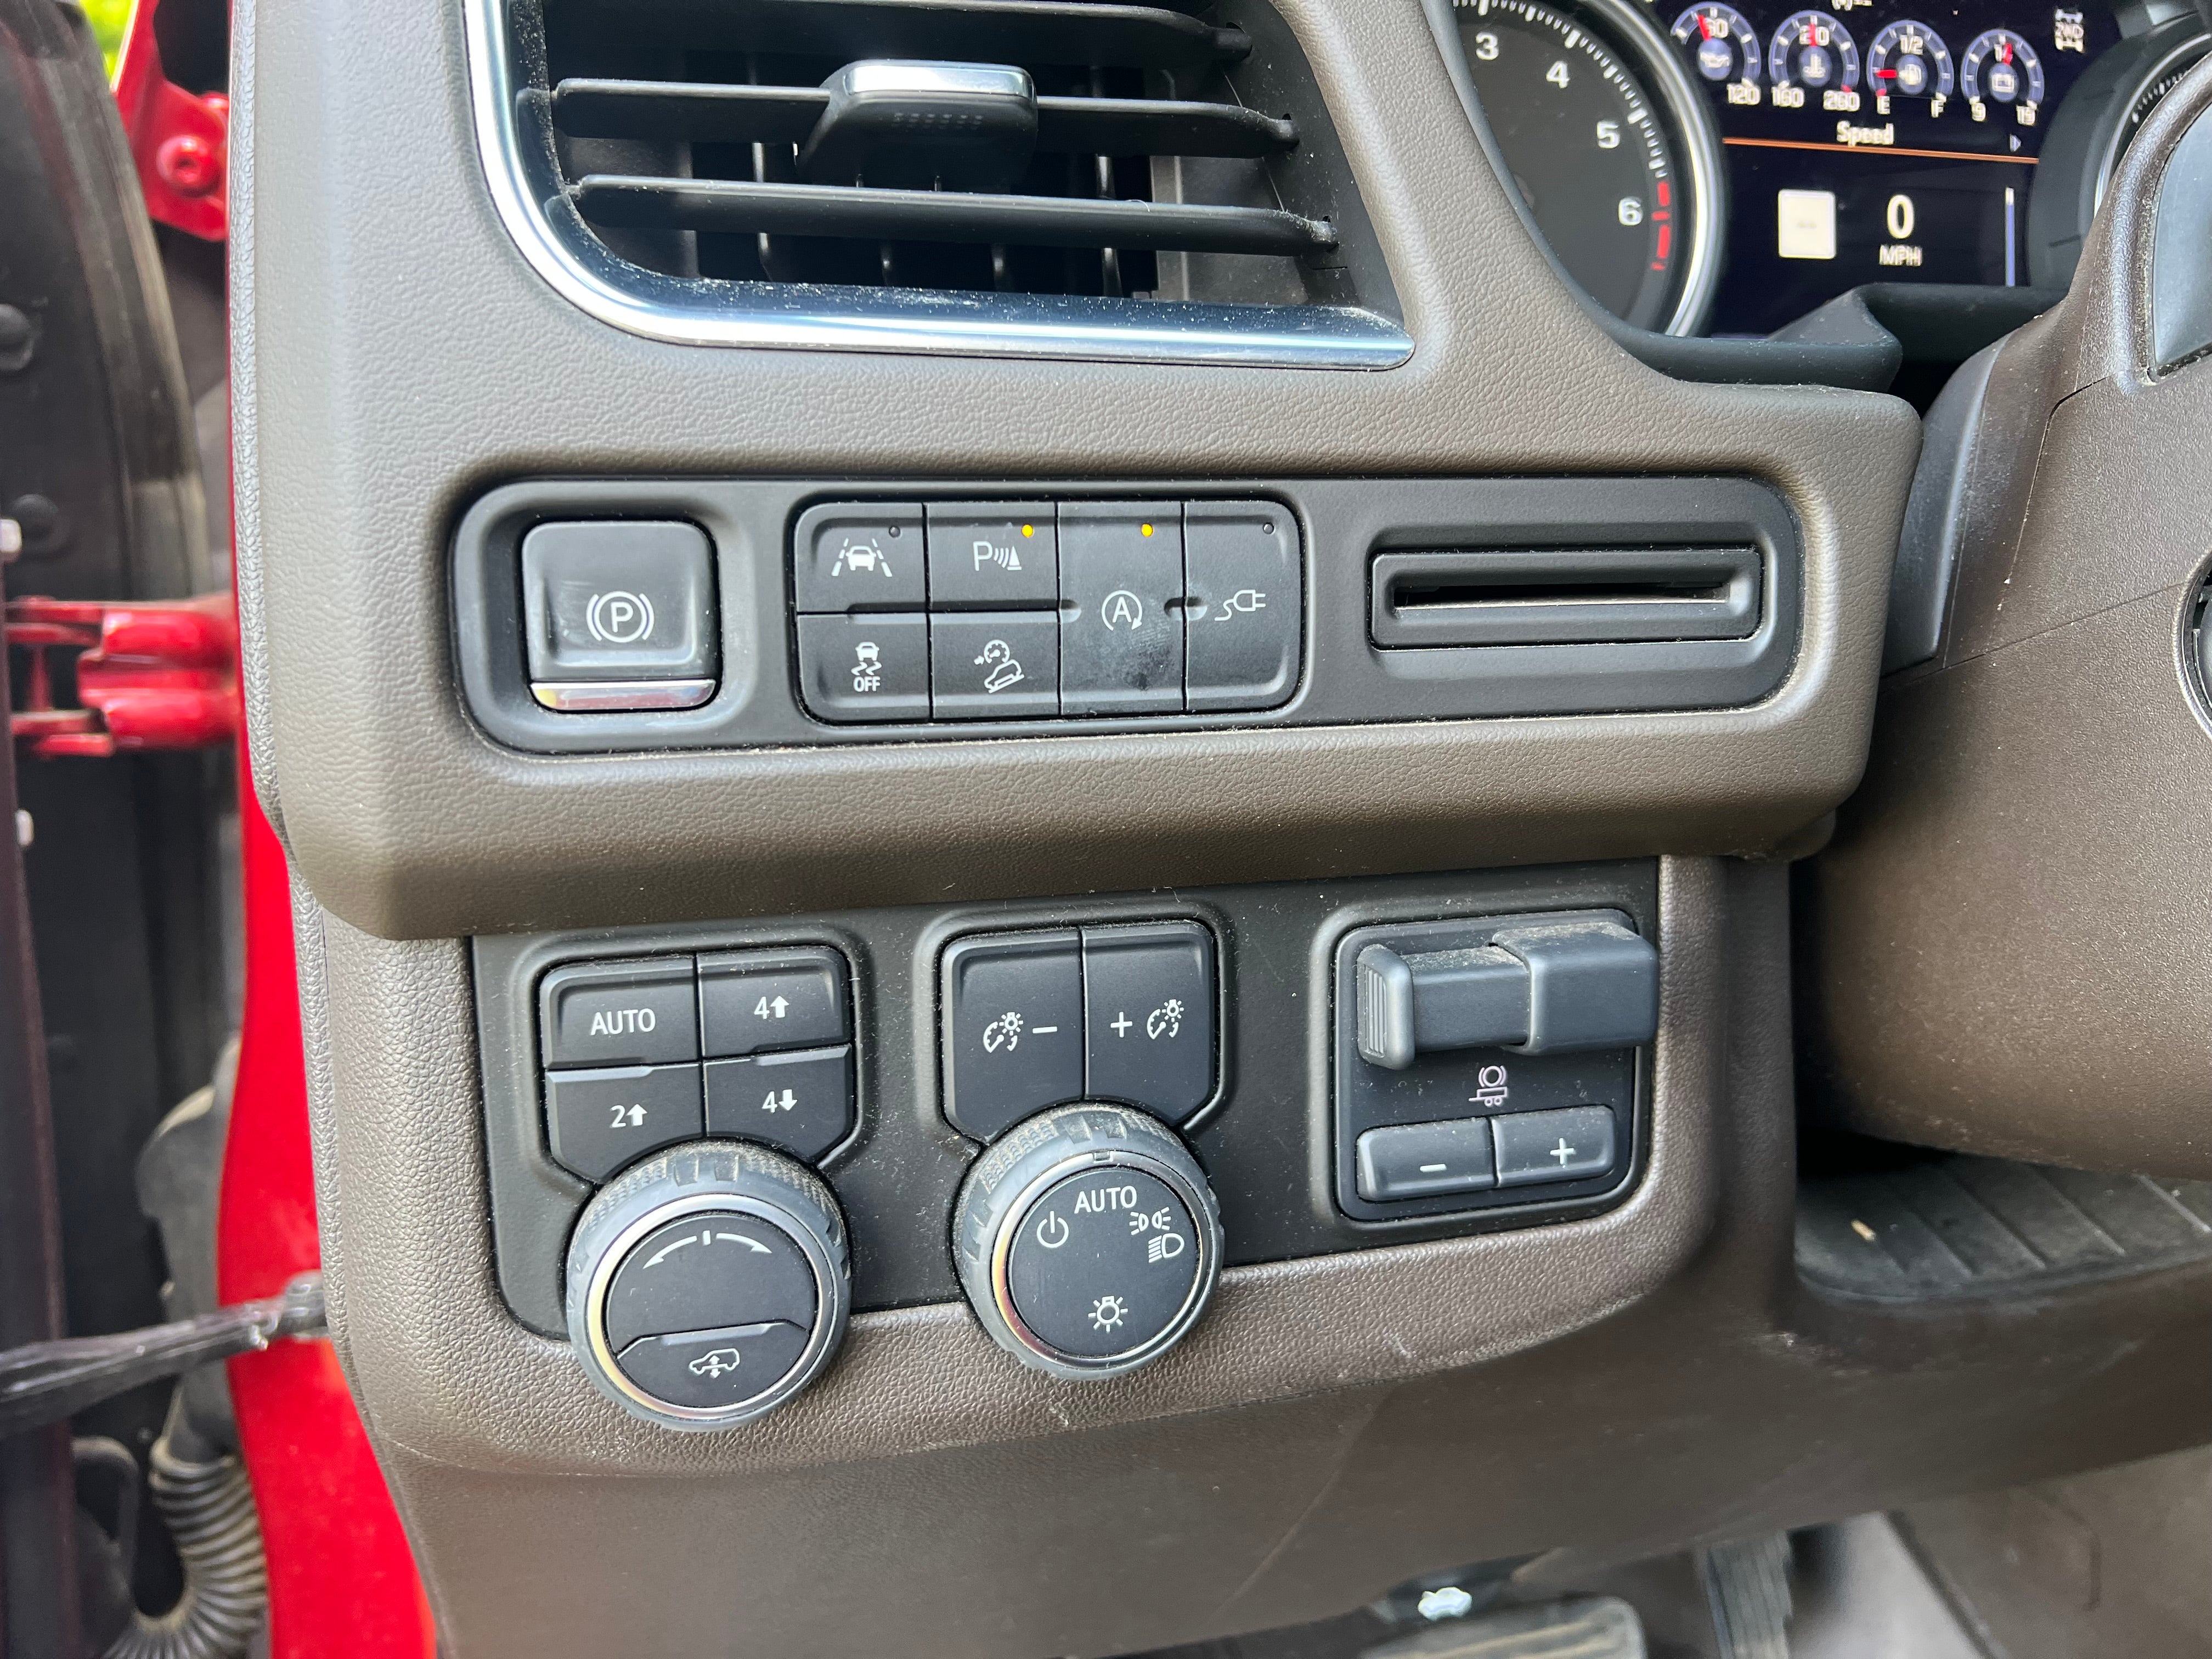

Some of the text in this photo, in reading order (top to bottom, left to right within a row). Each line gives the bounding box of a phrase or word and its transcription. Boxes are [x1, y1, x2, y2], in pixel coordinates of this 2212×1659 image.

[1475, 32, 1499, 61] 3
[1799, 25, 1830, 46] 20
[1900, 35, 1923, 55] 1/2
[1546, 61, 1570, 89] 4
[1727, 83, 1760, 105] 120
[1771, 86, 1804, 108] 160
[1877, 95, 1891, 115] E
[1931, 99, 1945, 118] F
[1971, 102, 1986, 122] 9
[1596, 121, 1621, 149] 5
[1836, 120, 1894, 147] Speed
[1618, 197, 1643, 226] 6
[1886, 194, 1914, 239] 0
[1879, 245, 1922, 266] MPH
[974, 541, 992, 571] P
[610, 602, 634, 633] P
[853, 678, 881, 692] OFF
[754, 996, 769, 1019] 4
[590, 1008, 656, 1035] AUTO
[761, 1091, 777, 1113] 4
[611, 1105, 627, 1128] 2
[1074, 1185, 1137, 1214] AUTO
